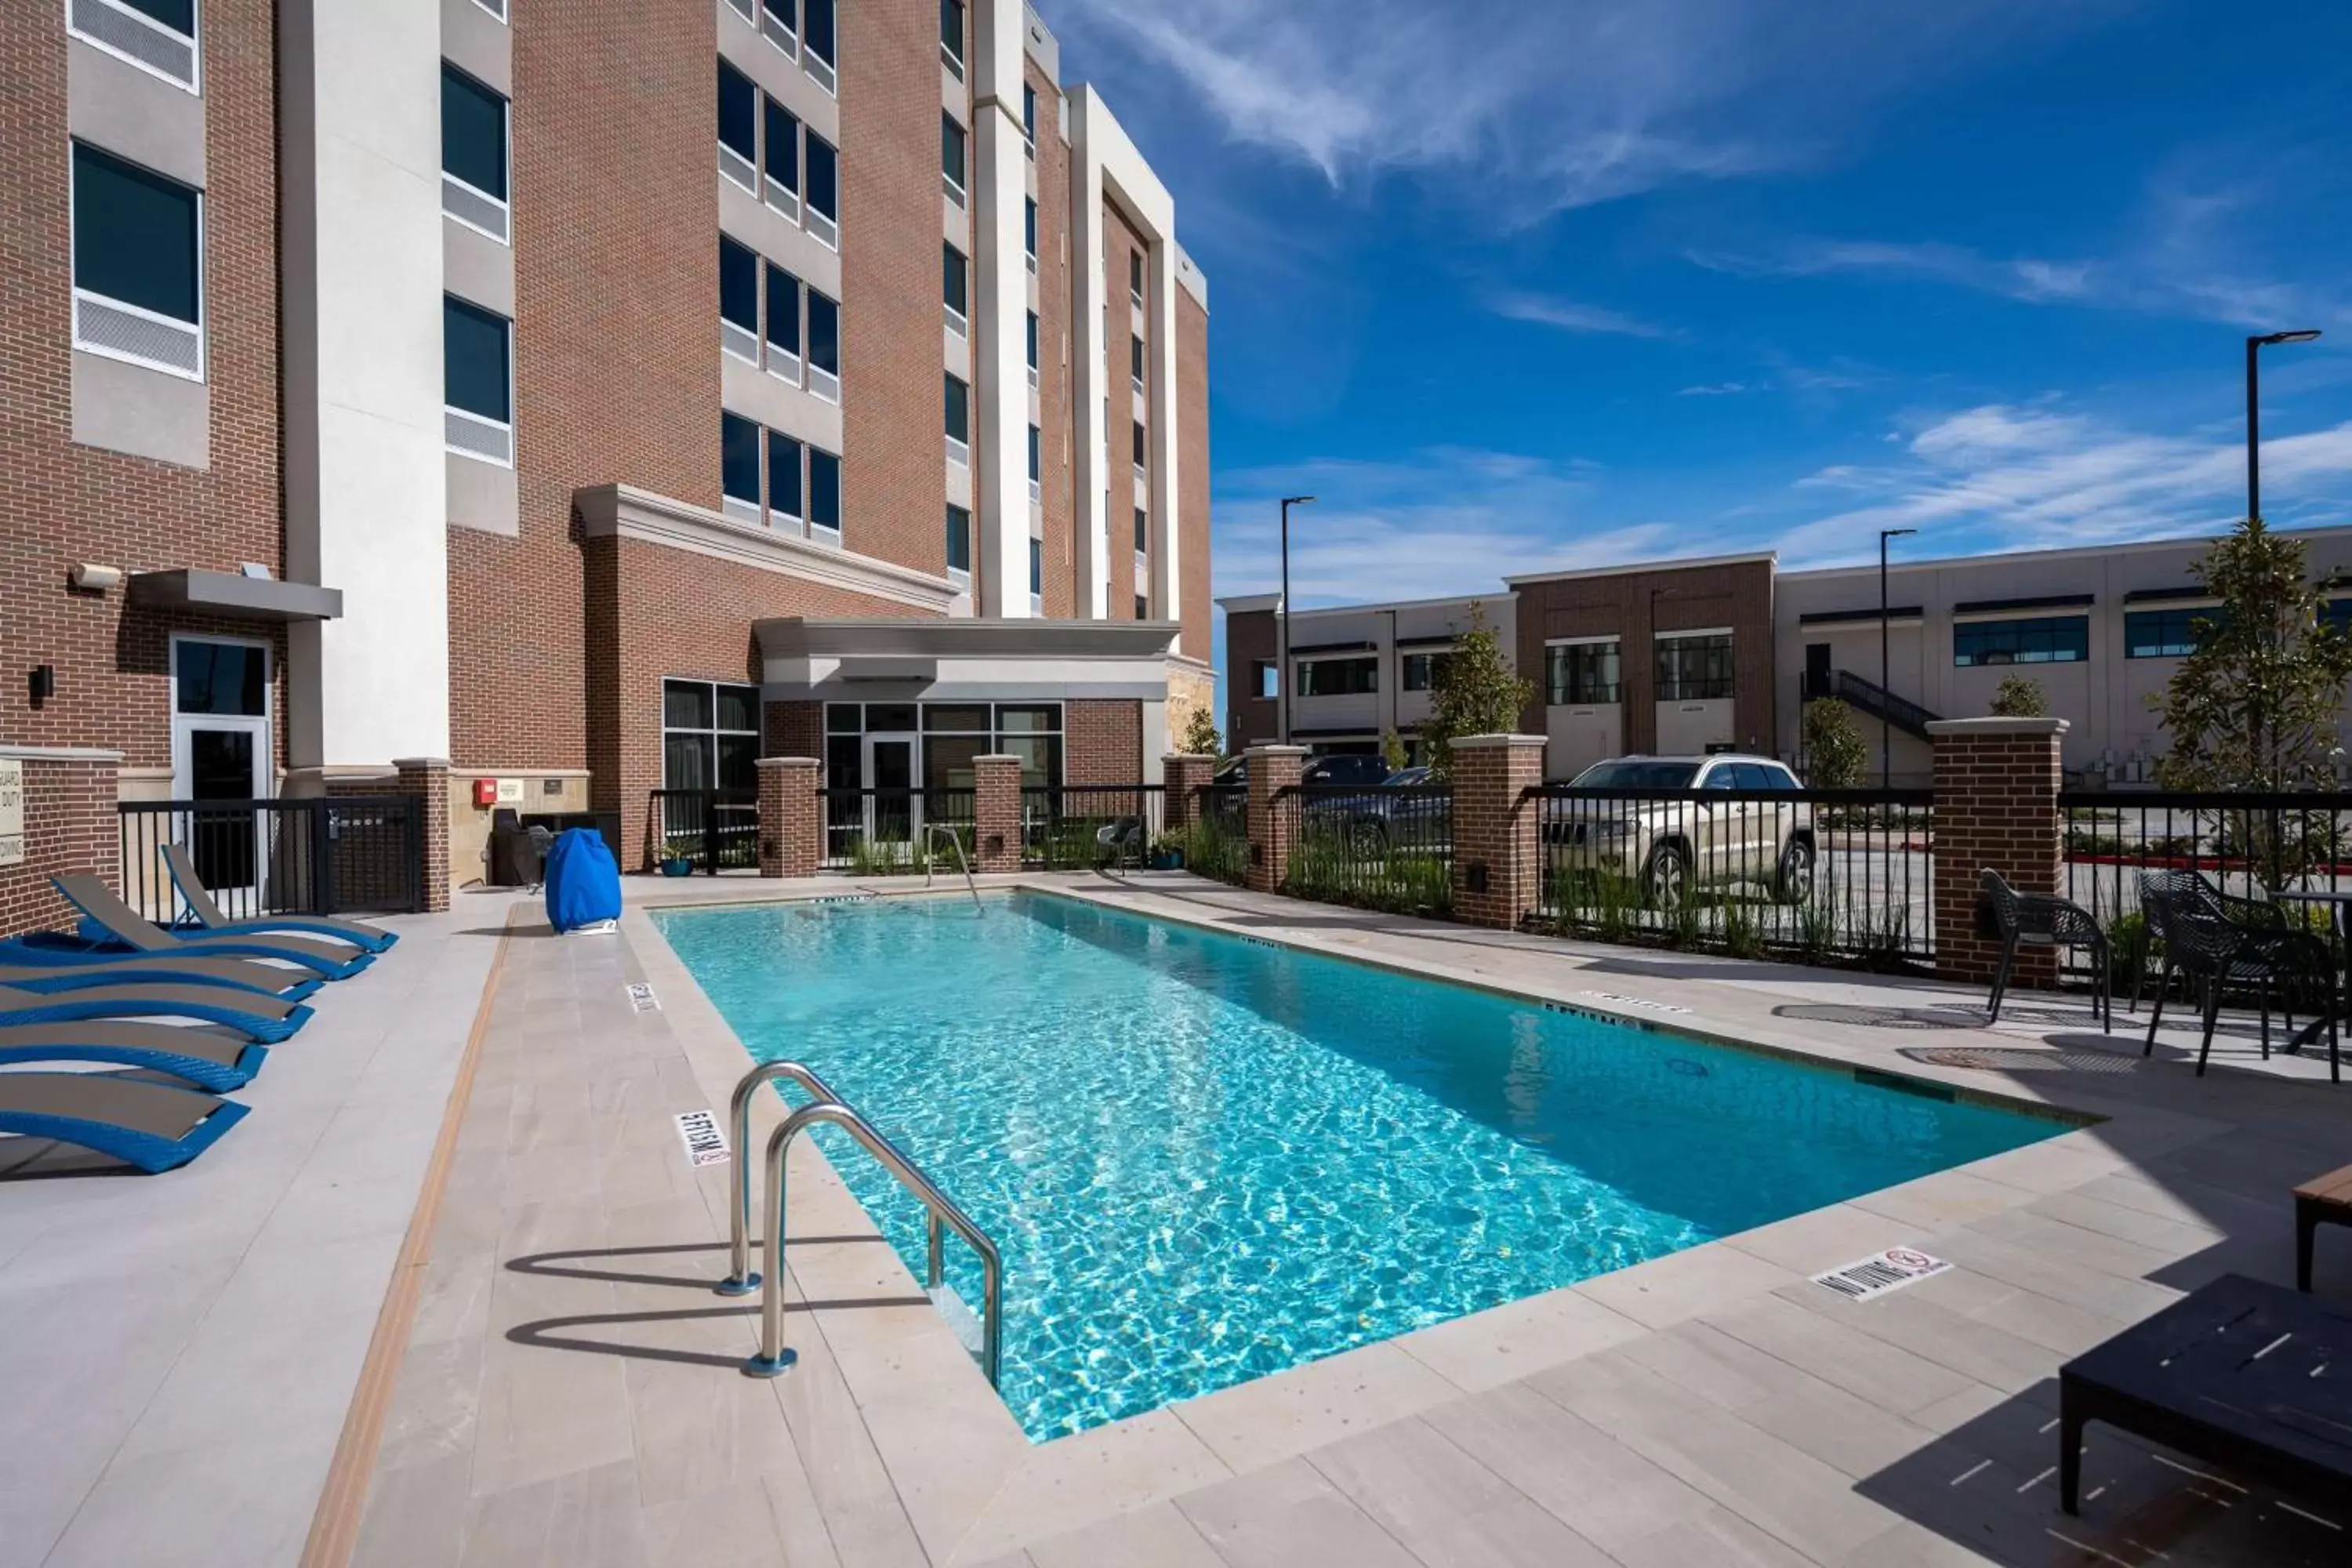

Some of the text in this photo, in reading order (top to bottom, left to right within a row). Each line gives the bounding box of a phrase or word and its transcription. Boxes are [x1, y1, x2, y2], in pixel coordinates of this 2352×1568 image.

[2, 790, 21, 807] DUTY
[683, 1120, 713, 1131] FT
[690, 1139, 724, 1152] M
[1839, 1260, 1914, 1290] DIVING
[1816, 1275, 1867, 1298] NO
